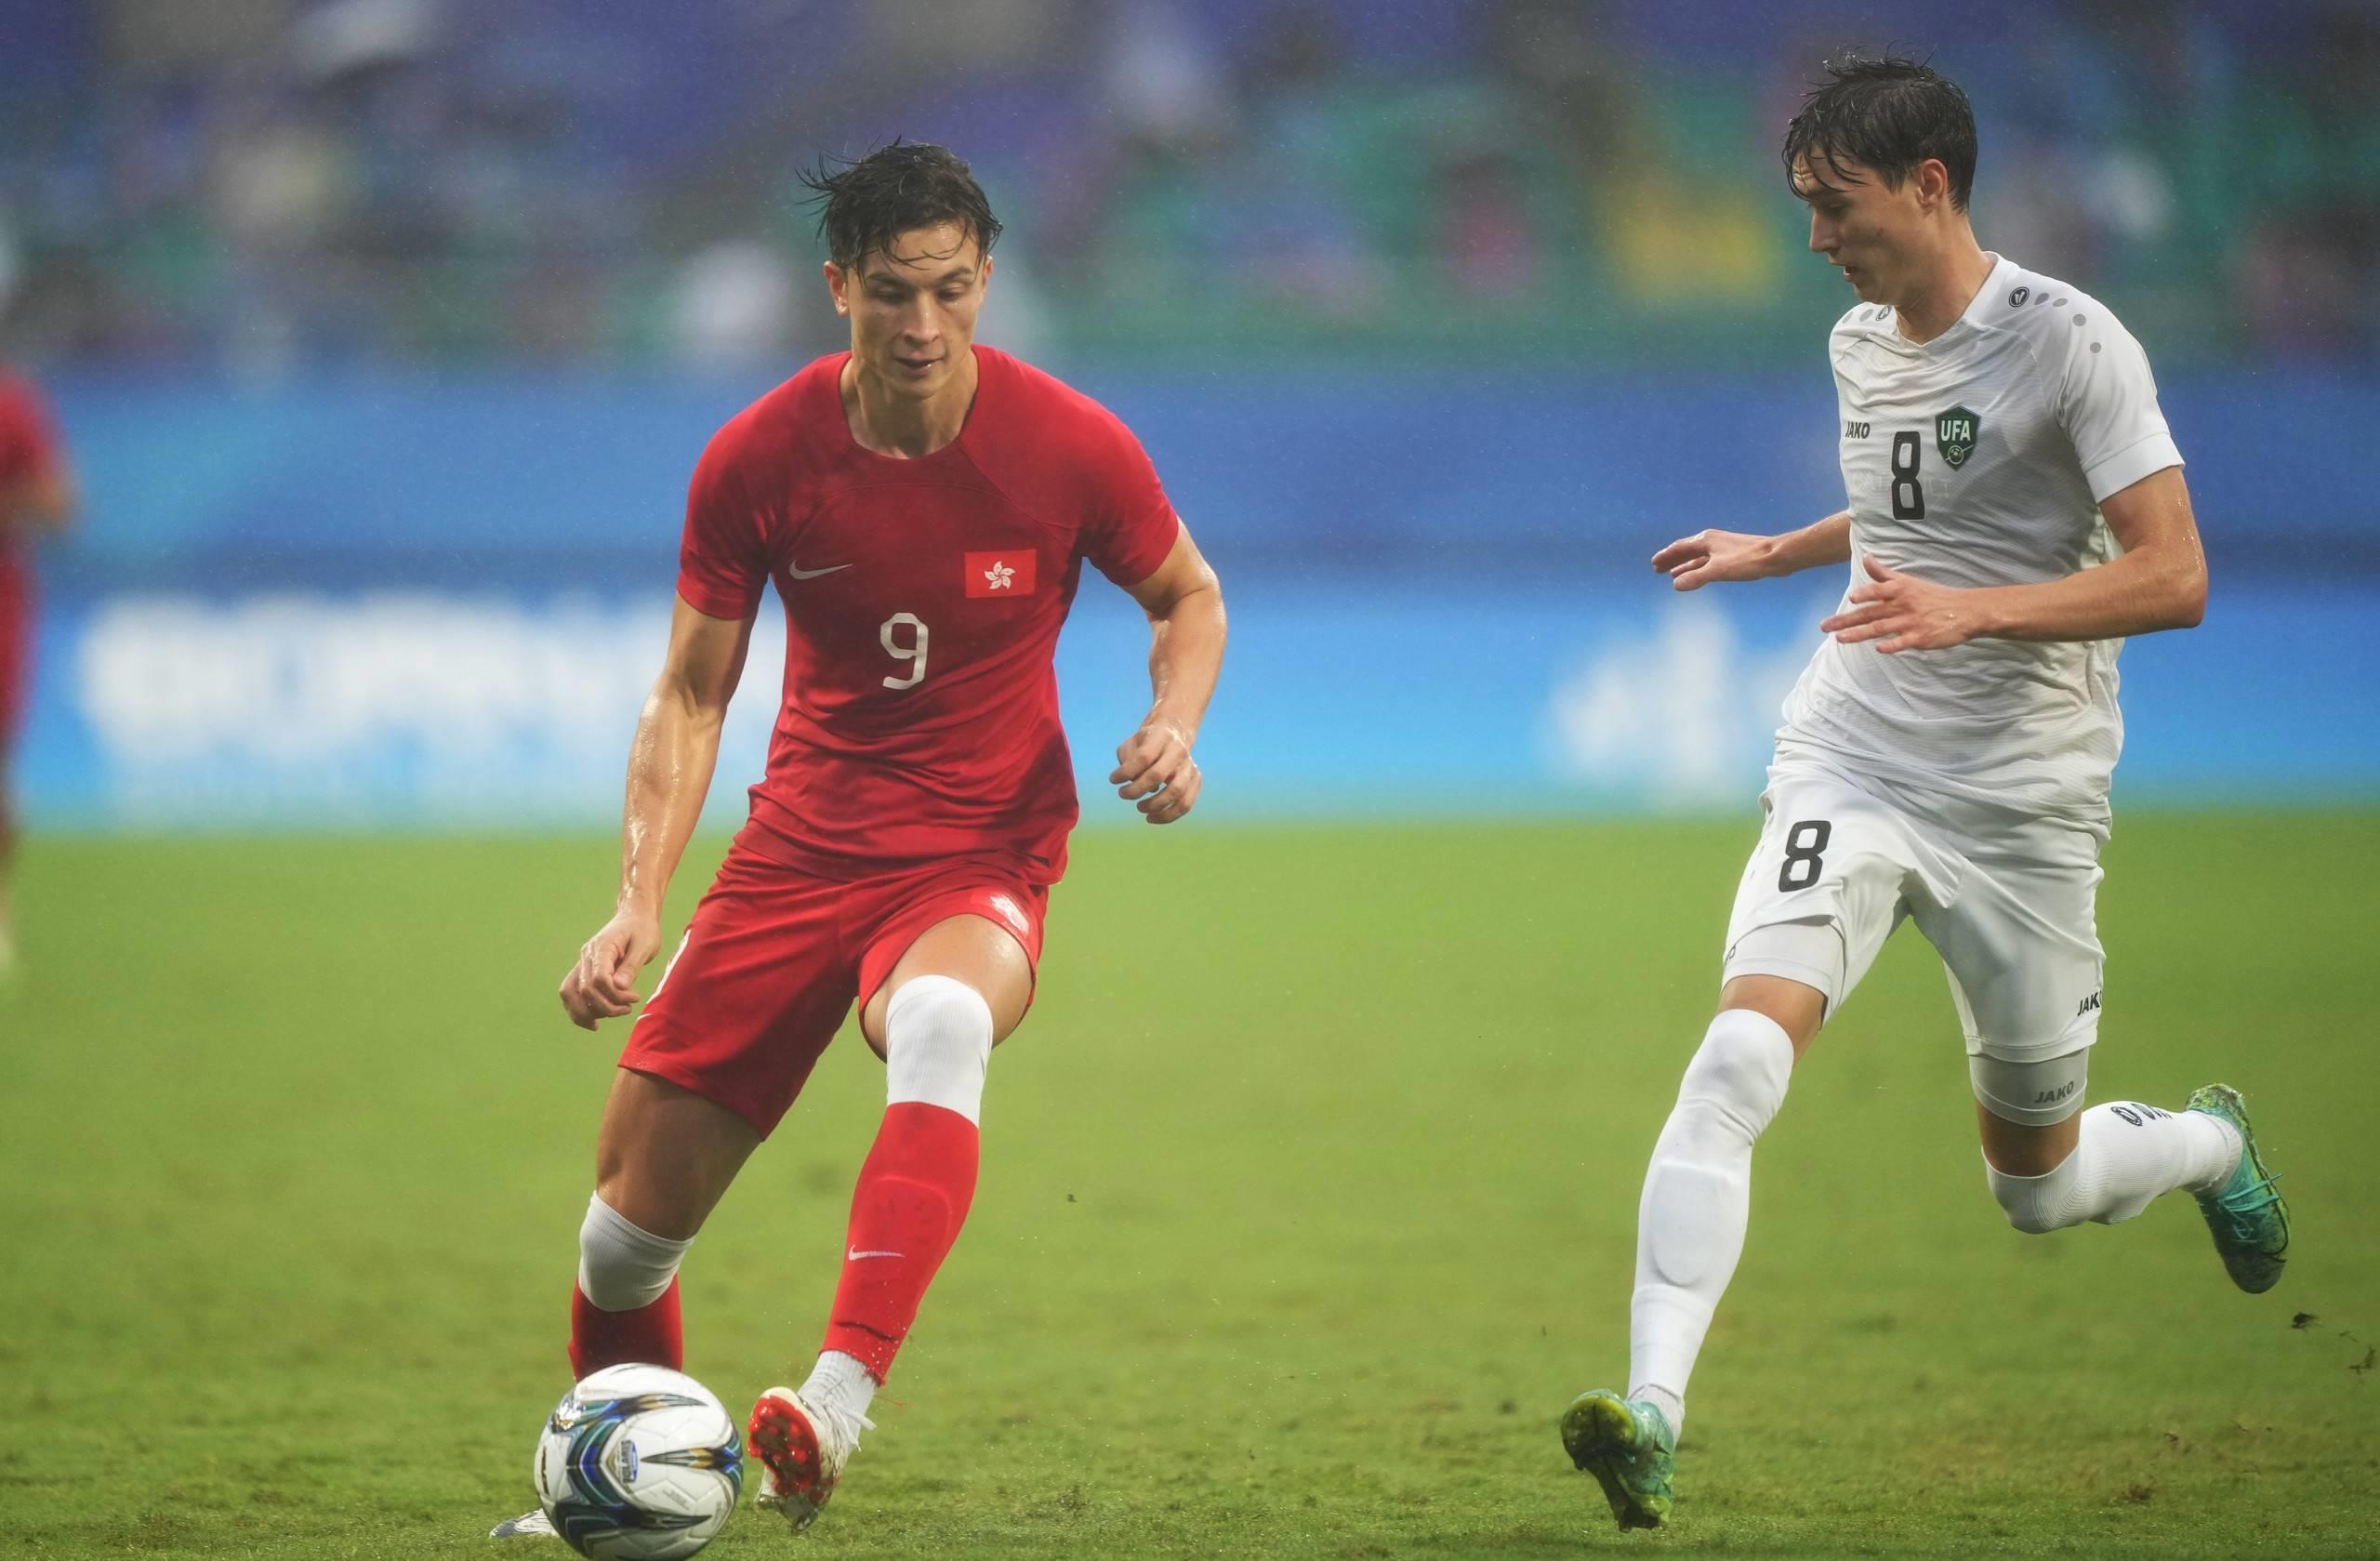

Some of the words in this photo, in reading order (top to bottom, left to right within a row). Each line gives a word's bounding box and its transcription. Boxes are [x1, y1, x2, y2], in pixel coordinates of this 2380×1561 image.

[1844, 421, 1871, 440] JAKO
[1940, 419, 1972, 442] UFA
[1891, 430, 1925, 521] 8
[879, 612, 929, 690] 9
[1778, 820, 1832, 893] 8
[2077, 989, 2102, 1016] JAK
[2034, 1080, 2075, 1104] JAKO
